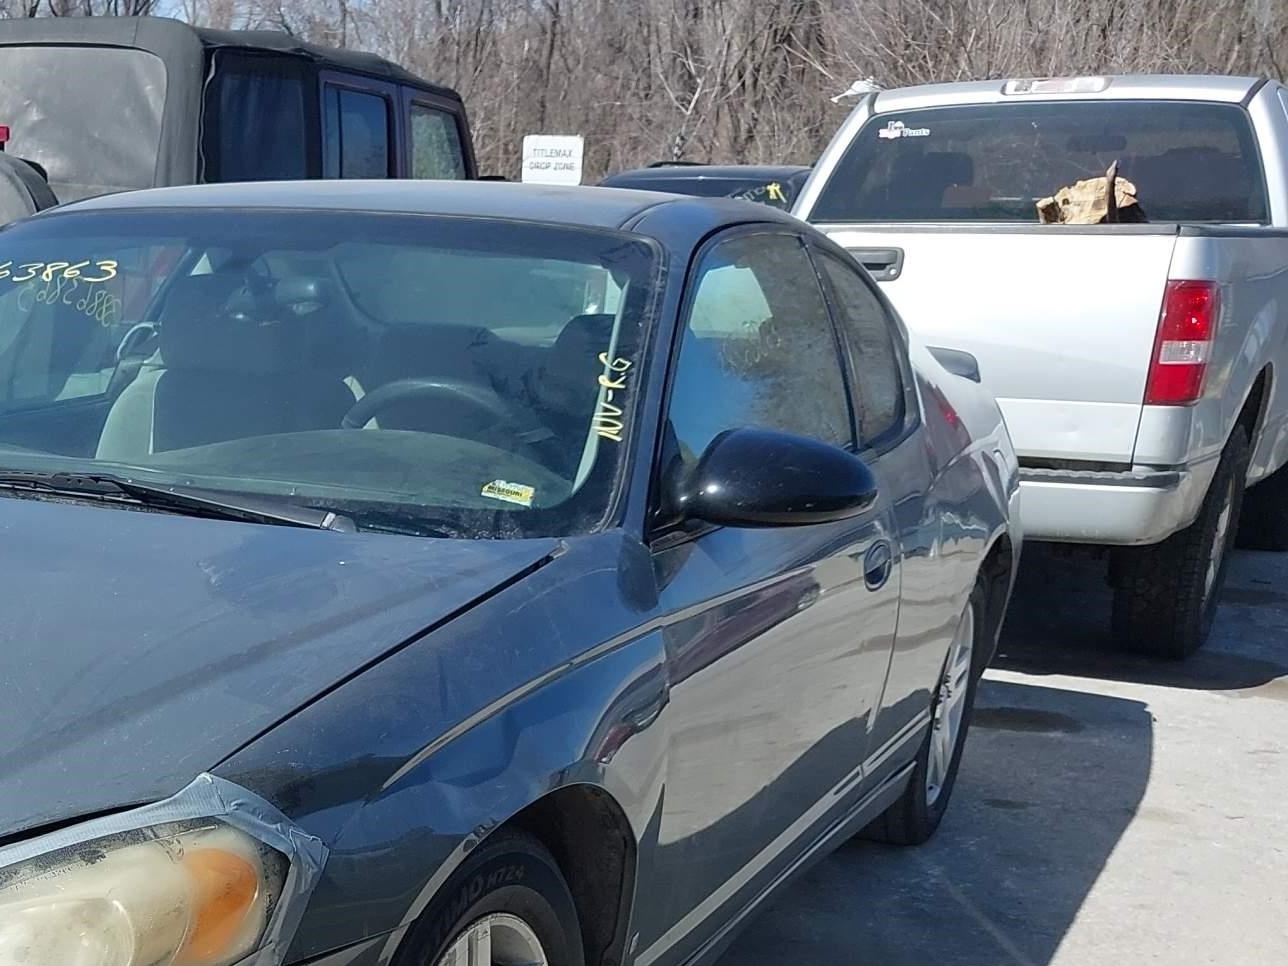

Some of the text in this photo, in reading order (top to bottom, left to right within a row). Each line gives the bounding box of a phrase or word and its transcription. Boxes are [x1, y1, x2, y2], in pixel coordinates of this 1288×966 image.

[533, 148, 573, 158] TITLEMAX
[529, 161, 576, 171] DROP ZONE
